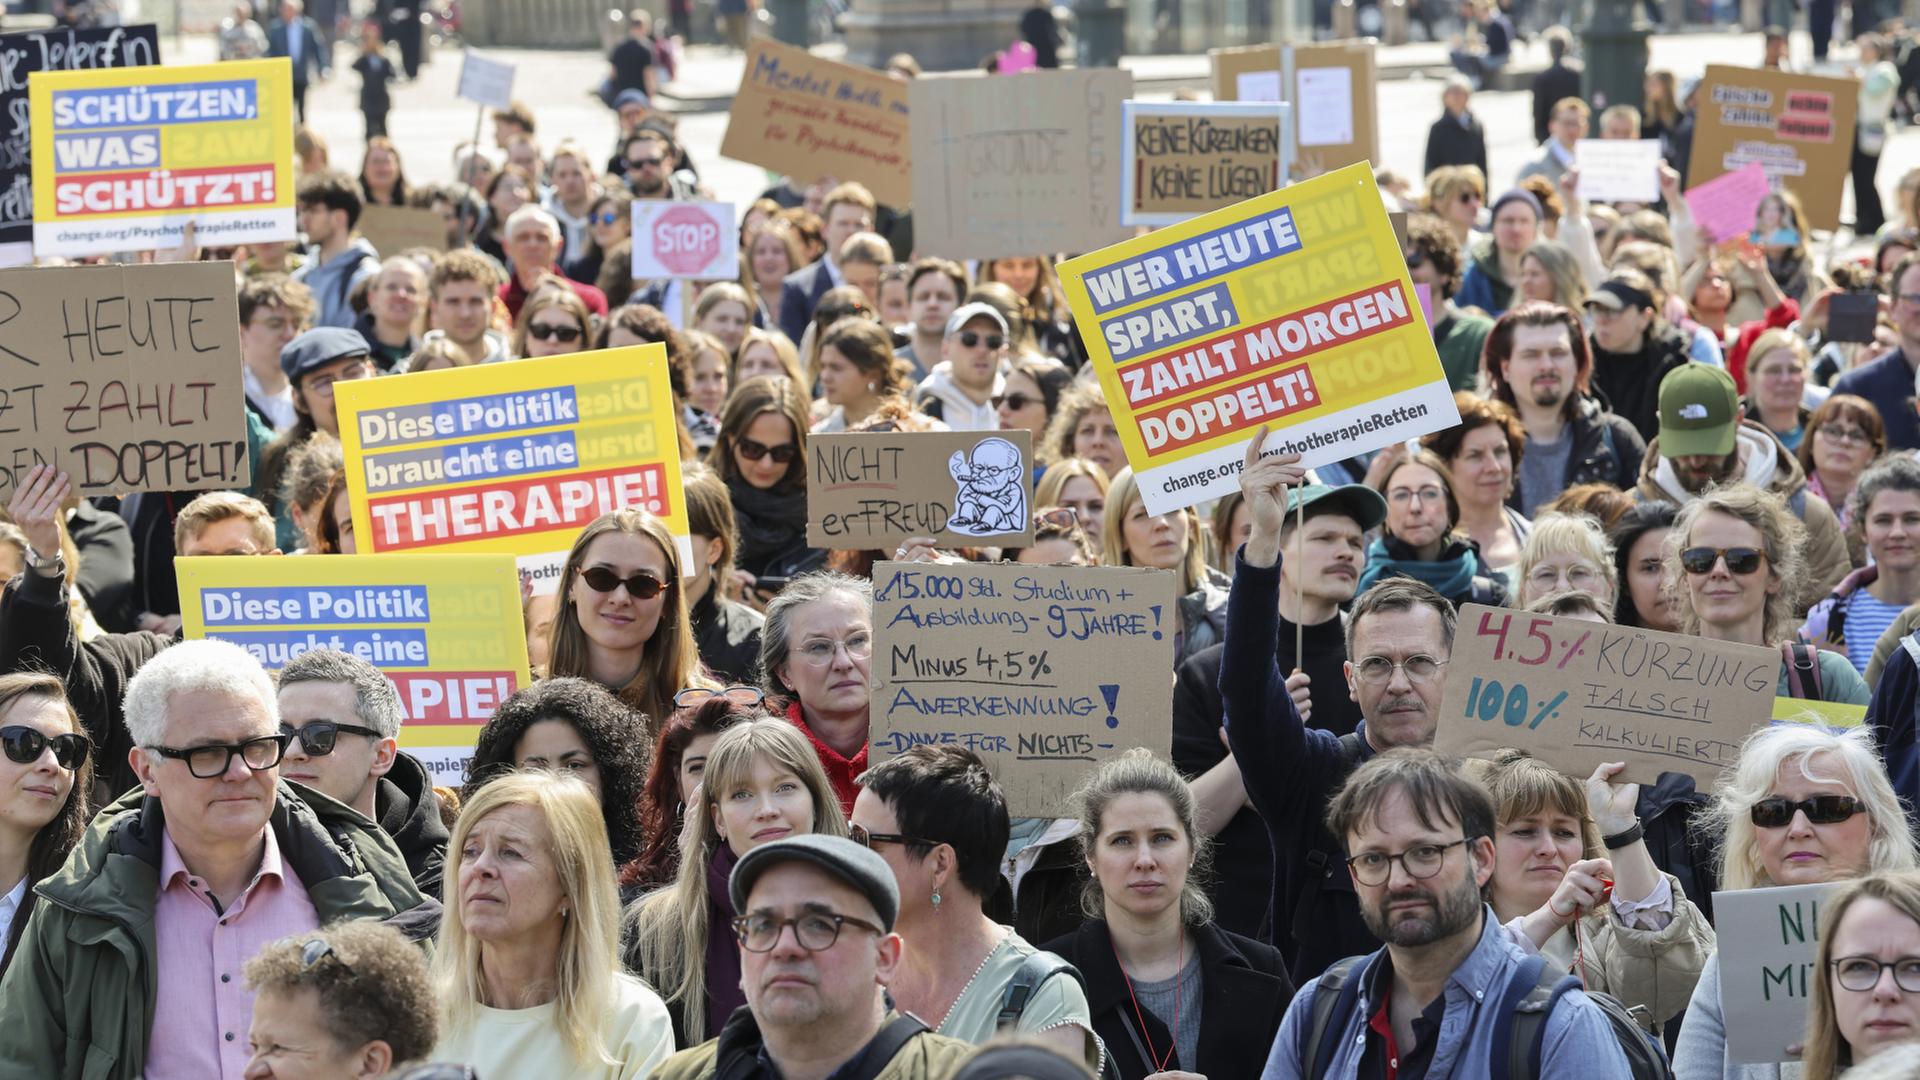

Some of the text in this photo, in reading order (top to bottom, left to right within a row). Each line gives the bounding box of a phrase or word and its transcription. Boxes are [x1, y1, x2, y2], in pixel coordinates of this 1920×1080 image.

[54, 87, 256, 126] SCHÜTZEN,
[55, 134, 158, 169] WAS
[56, 170, 275, 213] SCHÜTZT!
[1150, 163, 1203, 200] KEINE
[1209, 158, 1268, 199] LÜGEN
[56, 219, 276, 243] change.org/PsychoterapieRetten
[656, 222, 717, 254] STOP
[1085, 213, 1298, 307] WER HEUTE
[63, 296, 220, 363] HEUTE
[1104, 291, 1233, 355] SPART,
[1122, 287, 1408, 403] ZAHLT MORGEN
[64, 381, 216, 433] ZAHLT
[361, 391, 576, 444] Diese Politik
[1138, 369, 1315, 450] DOPPELT!
[70, 440, 246, 489] DOPPELT!
[366, 440, 575, 487] braucht eine
[816, 445, 904, 484] NICHT
[371, 470, 661, 544] THERAPIE!
[823, 500, 949, 536] erFREUD
[204, 589, 427, 621] Diese Politik
[881, 570, 963, 600] 15.000
[968, 577, 1002, 598] Std.
[1013, 576, 1110, 603] Studium
[1116, 589, 1134, 601] +
[353, 633, 424, 661] eine
[891, 645, 967, 677] MINUS
[1597, 630, 1769, 692] KÜRZUNG
[1464, 677, 1569, 730] 100%
[1584, 683, 1711, 719] FALSCH
[1578, 719, 1740, 761] KALKULIERT
